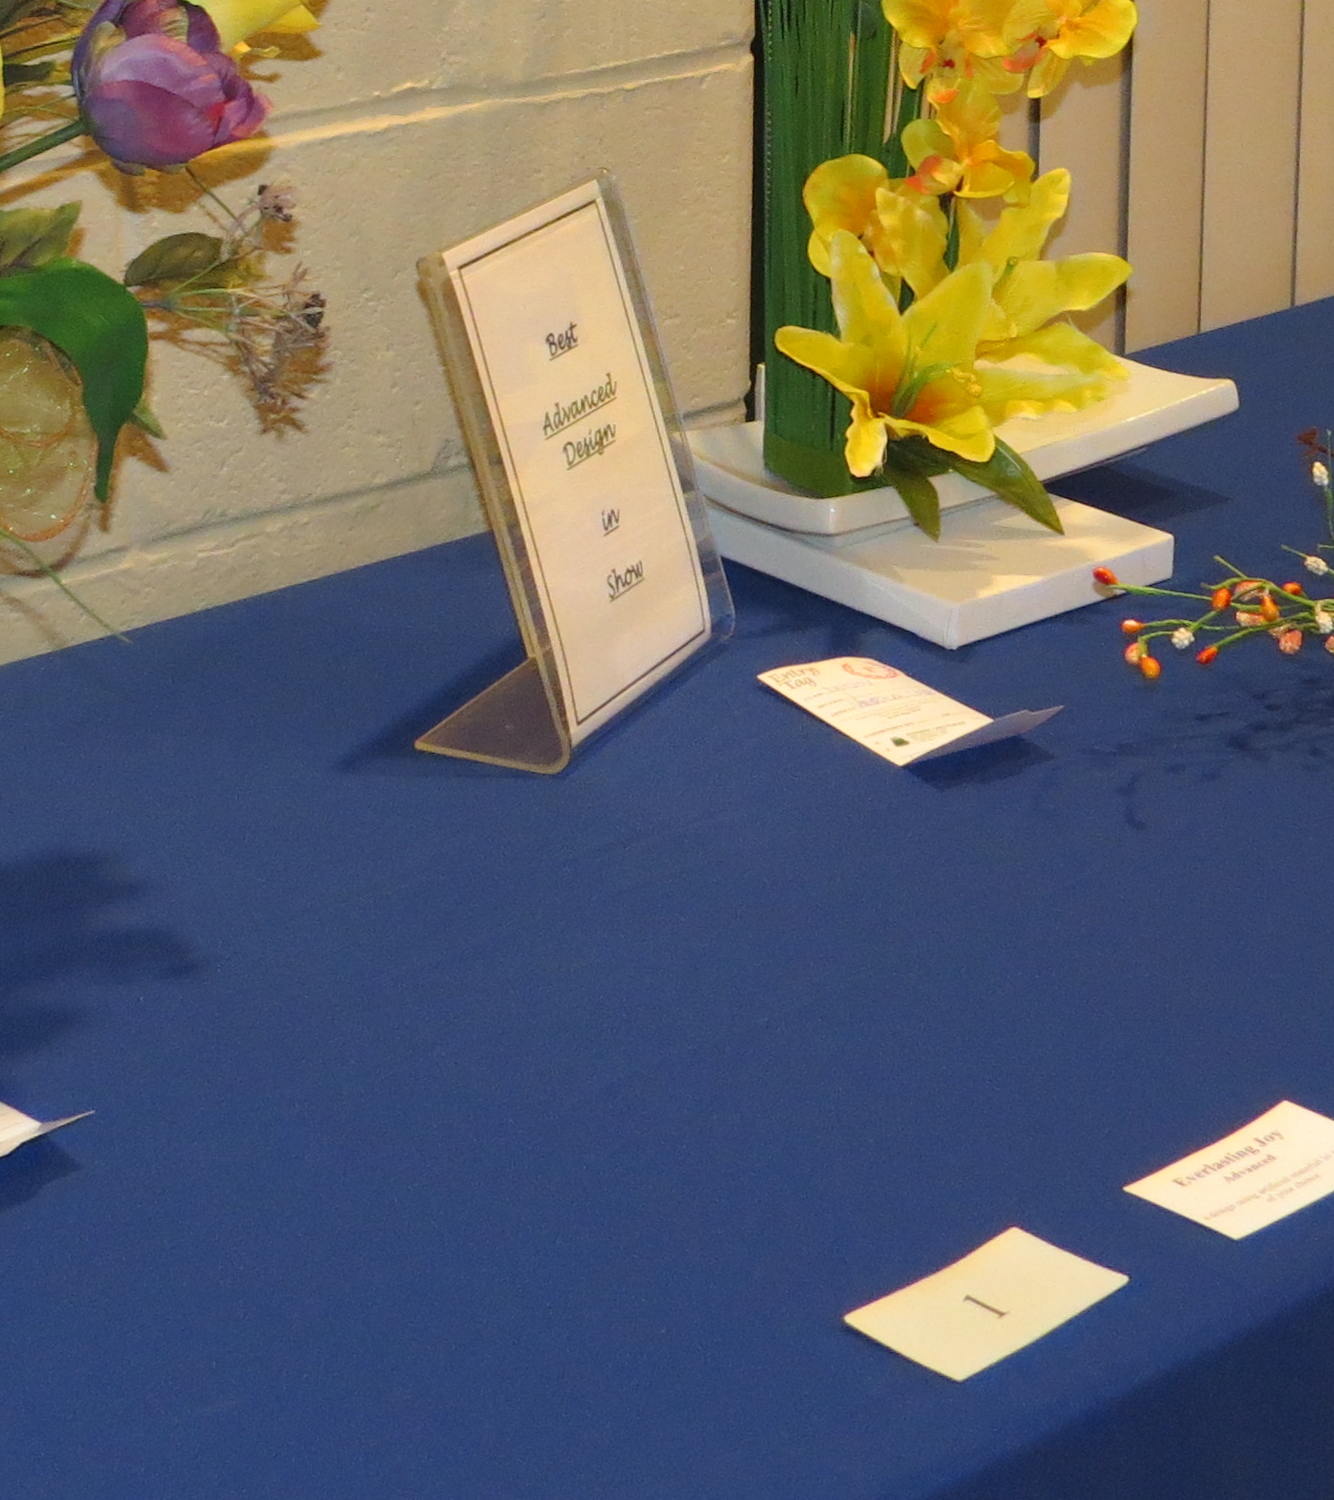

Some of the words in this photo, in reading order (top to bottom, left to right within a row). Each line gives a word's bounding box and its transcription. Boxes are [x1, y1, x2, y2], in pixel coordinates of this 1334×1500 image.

[545, 322, 579, 358] Best
[542, 372, 618, 437] Advanced
[562, 423, 617, 467] Design
[601, 508, 621, 532] in
[606, 560, 645, 600] Show
[767, 666, 821, 684] Entry
[779, 675, 818, 690] Tag
[1171, 1143, 1261, 1188] Everlasting
[1253, 1128, 1285, 1149] Joy
[1222, 1153, 1278, 1184] Advanced
